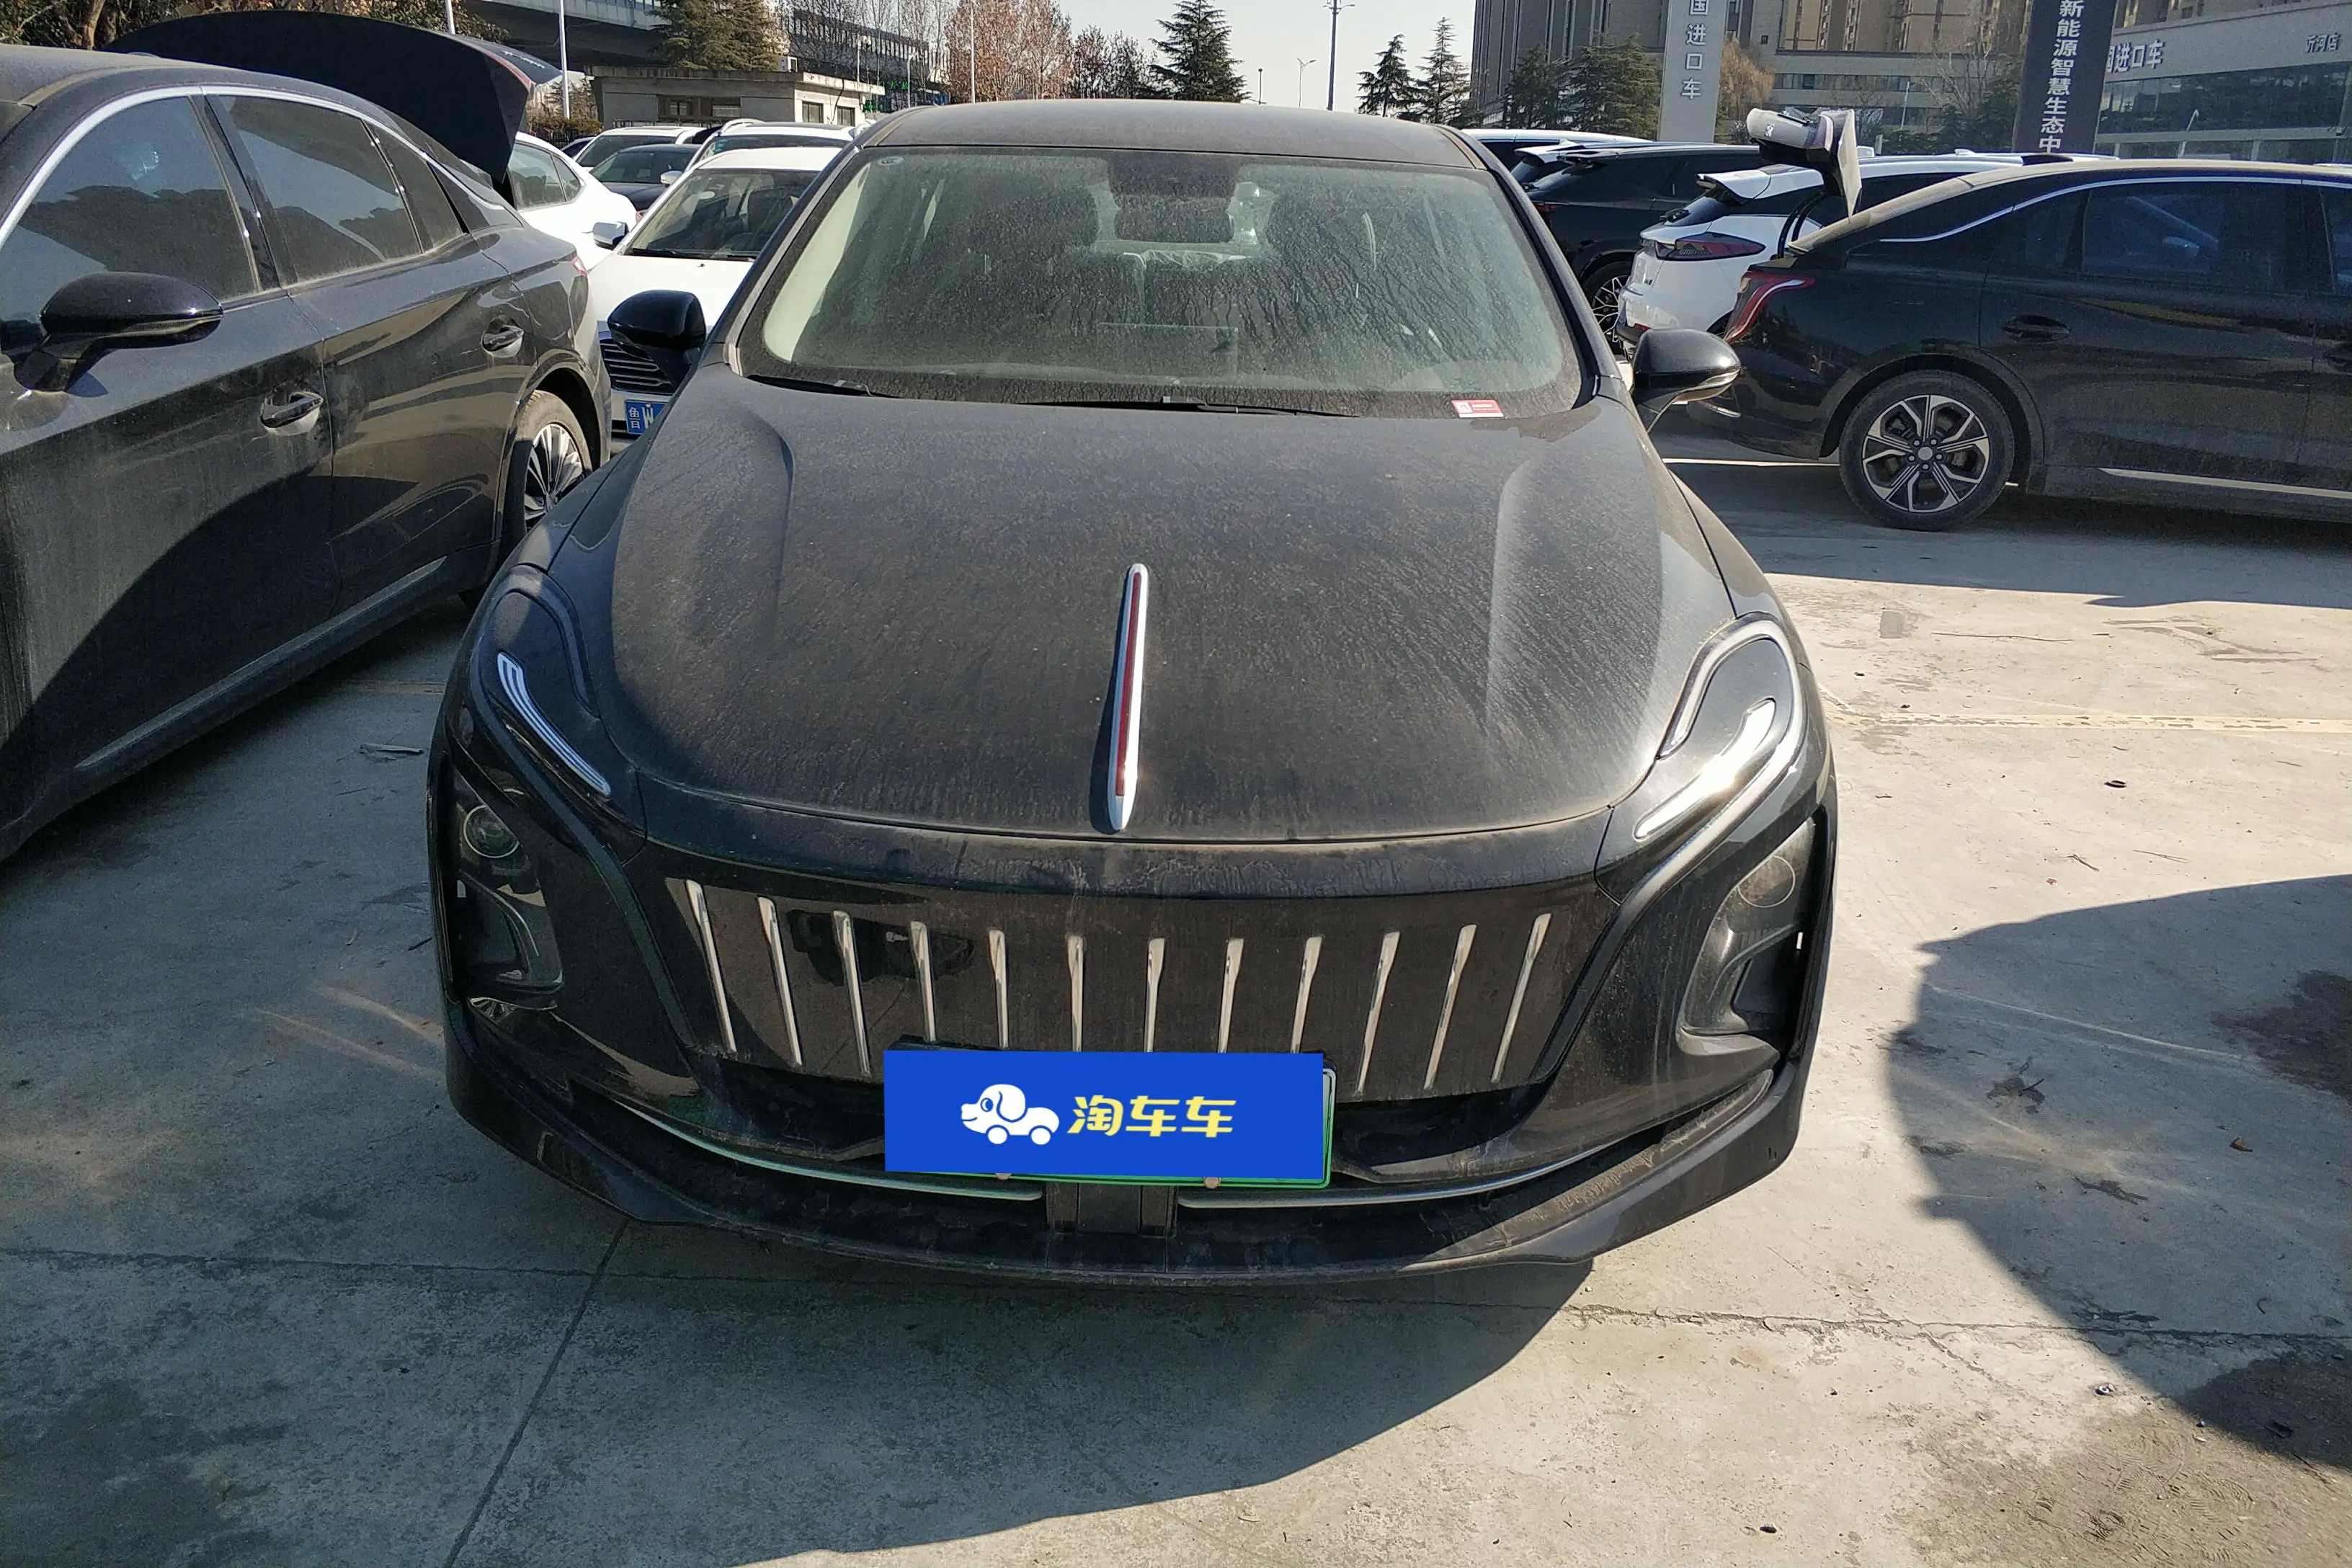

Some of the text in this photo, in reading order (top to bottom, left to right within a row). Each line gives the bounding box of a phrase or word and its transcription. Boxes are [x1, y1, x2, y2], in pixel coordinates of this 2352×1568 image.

[1681, 0, 1709, 99] 国进口车
[2039, 0, 2085, 153] 新能源智慧生态中
